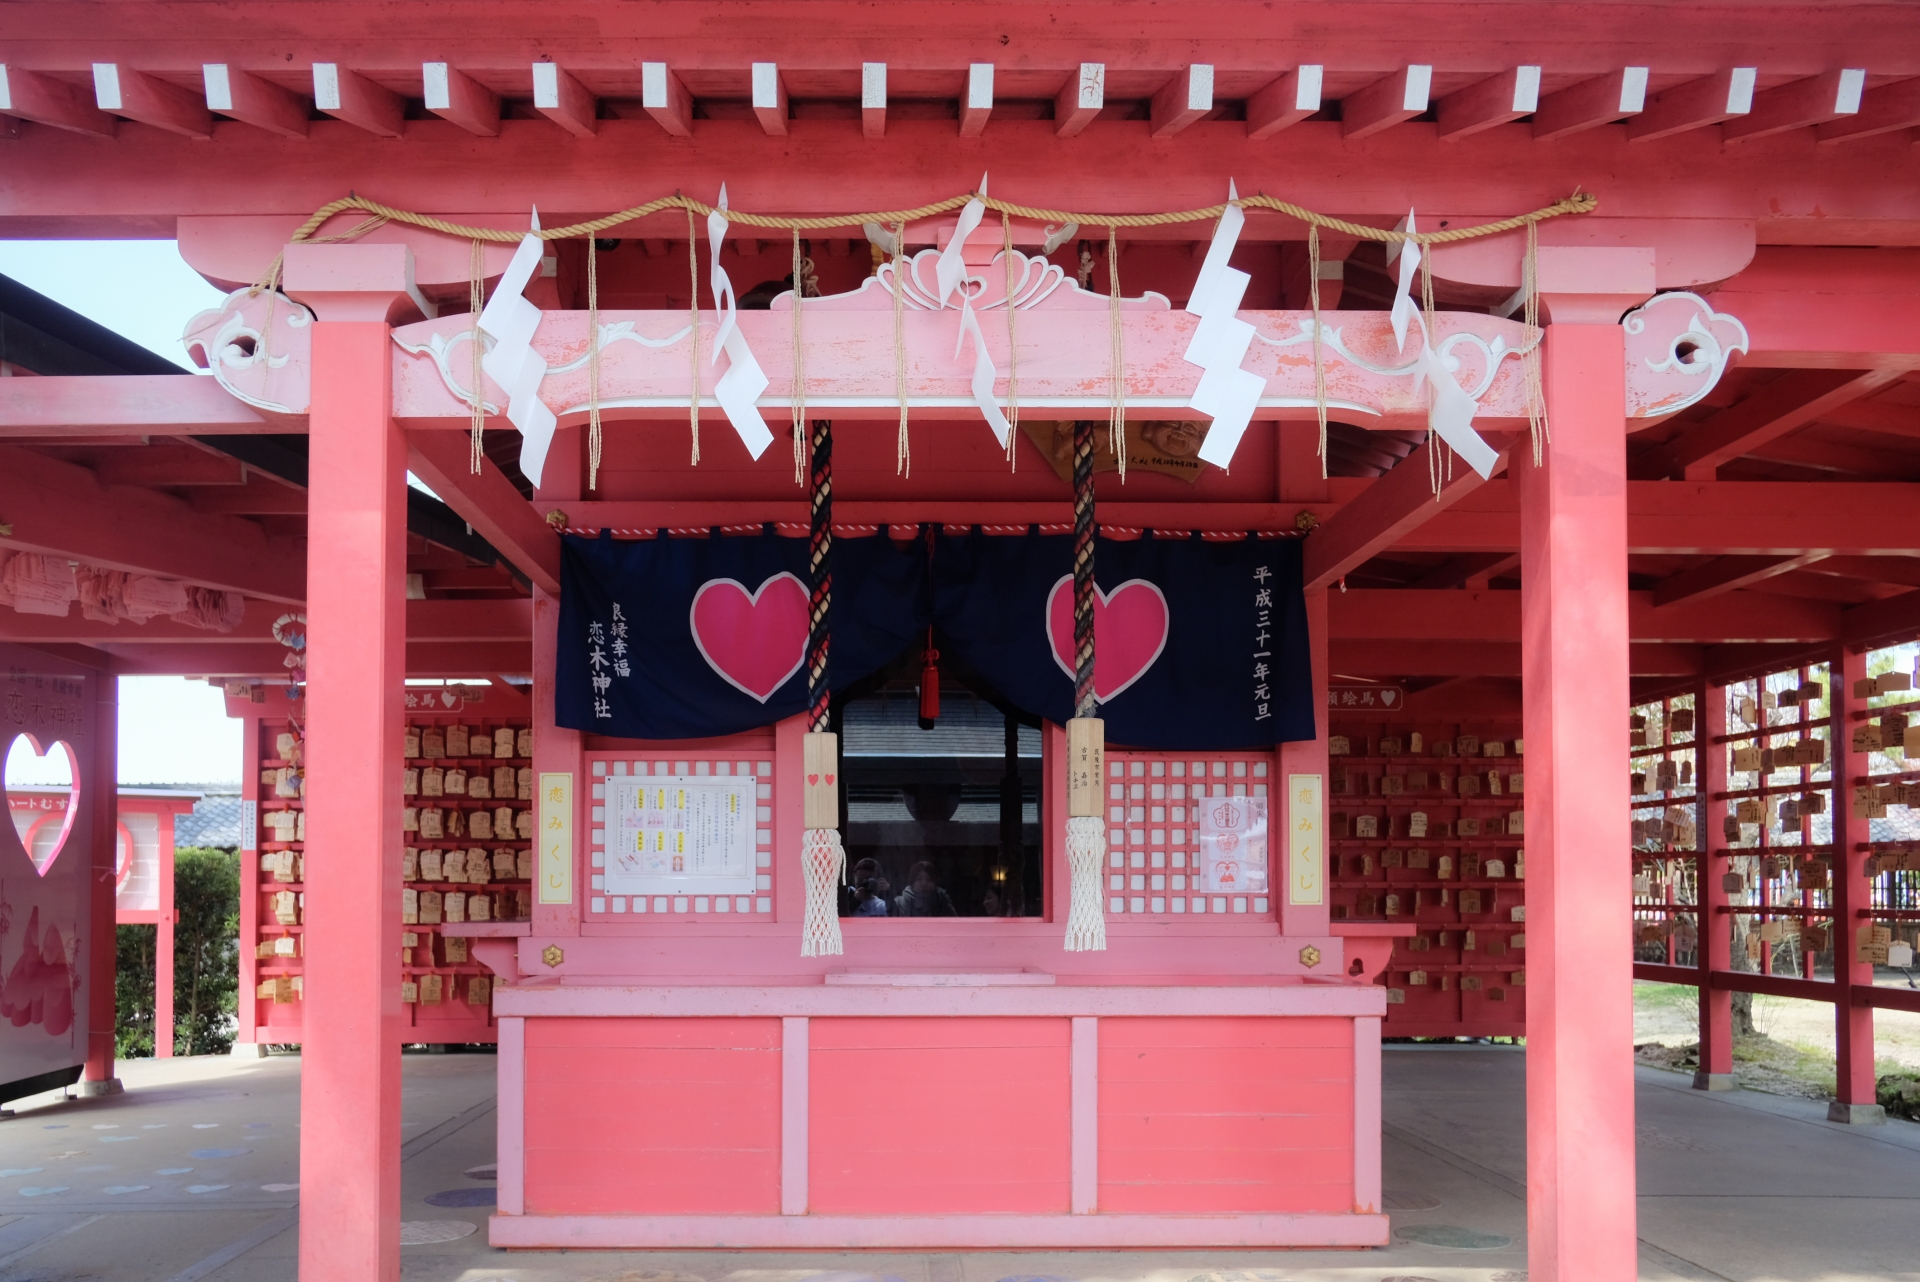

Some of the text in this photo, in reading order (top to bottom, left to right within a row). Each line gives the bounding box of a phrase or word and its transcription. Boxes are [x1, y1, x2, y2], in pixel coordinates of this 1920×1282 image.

[586, 620, 612, 720] 恋木神社
[609, 601, 631, 678] 良縁幸福
[1252, 564, 1273, 722] 平成三十一年元旦
[5, 690, 86, 738] 恋木神社
[547, 785, 564, 890] 恋みくじ
[1296, 786, 1315, 892] 恋みくじ
